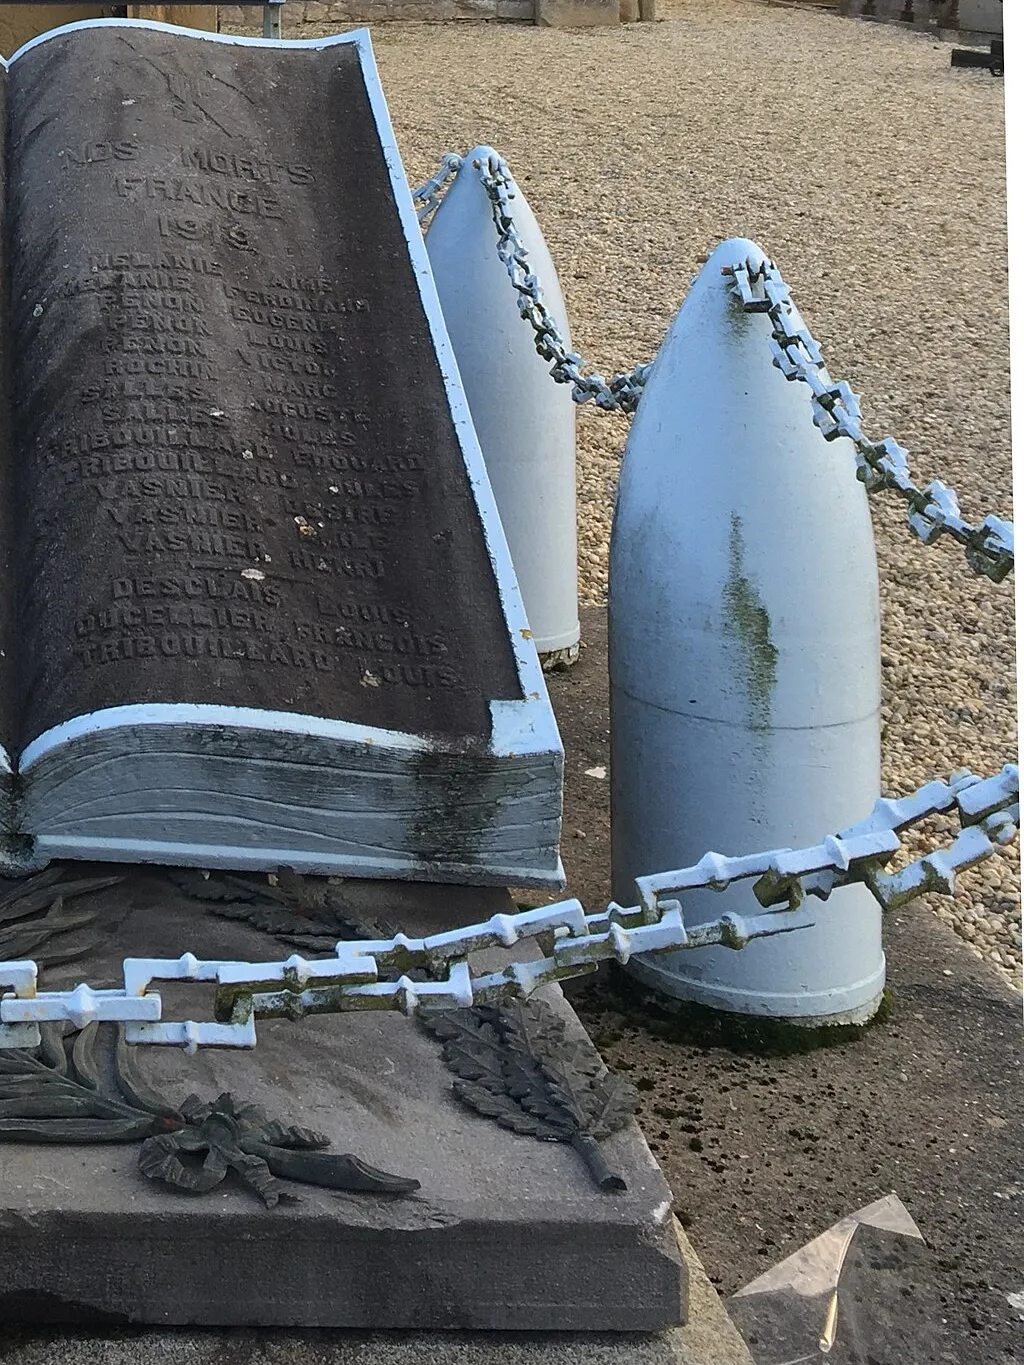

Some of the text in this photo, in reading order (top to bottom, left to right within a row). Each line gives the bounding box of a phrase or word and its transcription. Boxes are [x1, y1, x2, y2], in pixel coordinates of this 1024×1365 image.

[61, 140, 317, 187] NOS MORTS
[114, 176, 288, 223] FRANCE
[88, 252, 334, 295] MELANIE AIME
[222, 281, 371, 315] FERDINAND
[247, 330, 329, 357] LOUIS
[236, 349, 338, 378] VICTOR
[263, 377, 340, 400] MARC
[244, 396, 372, 425] AUGUSTE
[60, 448, 299, 491] TRIBOUILLARD
[91, 475, 246, 506] VASNIER
[106, 505, 265, 534] VASNIER
[116, 531, 387, 578] VASNIER HENRI
[112, 575, 413, 627] DESCLAIS LOUIS
[73, 604, 274, 638] DUCELLIER
[76, 635, 335, 673] TRIBOUILLARD
